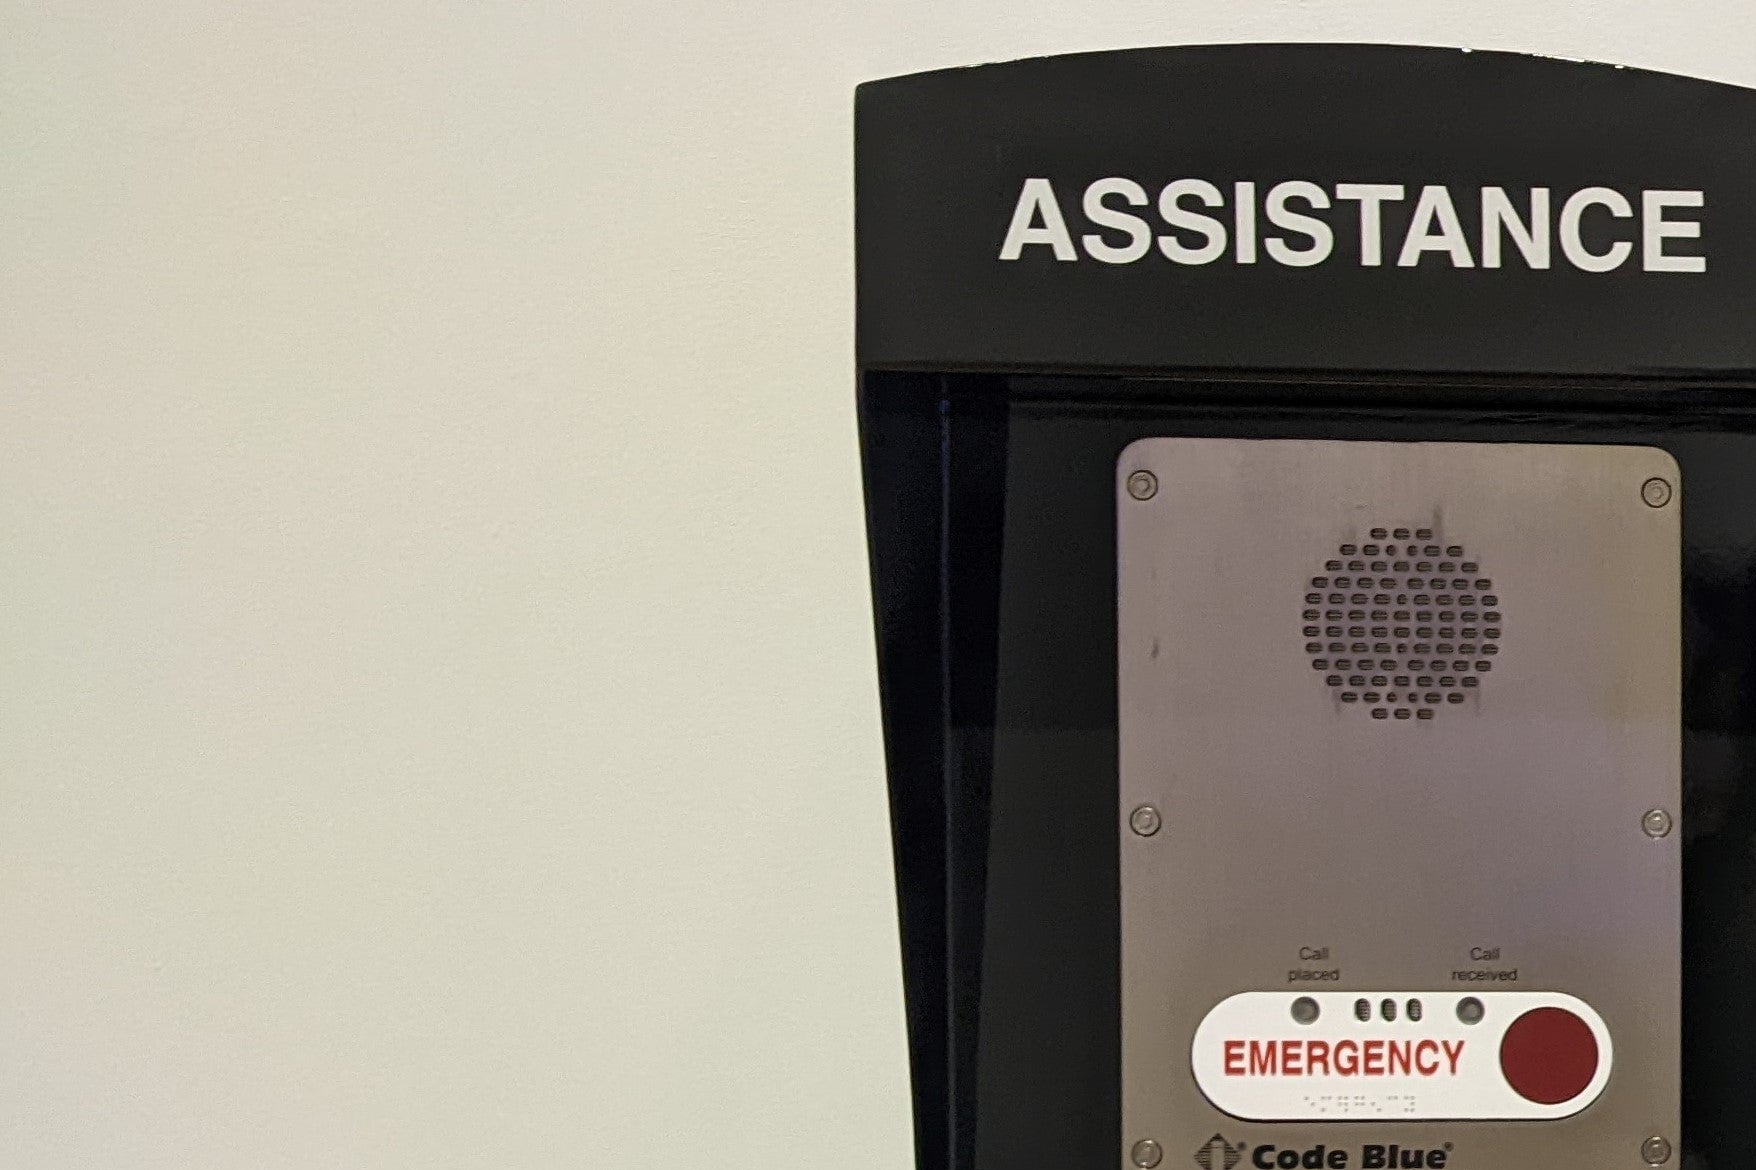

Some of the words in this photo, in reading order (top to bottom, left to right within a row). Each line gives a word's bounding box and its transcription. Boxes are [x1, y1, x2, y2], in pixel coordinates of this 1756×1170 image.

[998, 177, 1707, 274] ASSISTANCE
[1299, 946, 1329, 961] Call
[1470, 946, 1500, 961] Call
[1288, 967, 1340, 983] placed
[1452, 968, 1518, 982] received
[1223, 1039, 1465, 1076] EMERGENCY
[1252, 1144, 1348, 1170] Code
